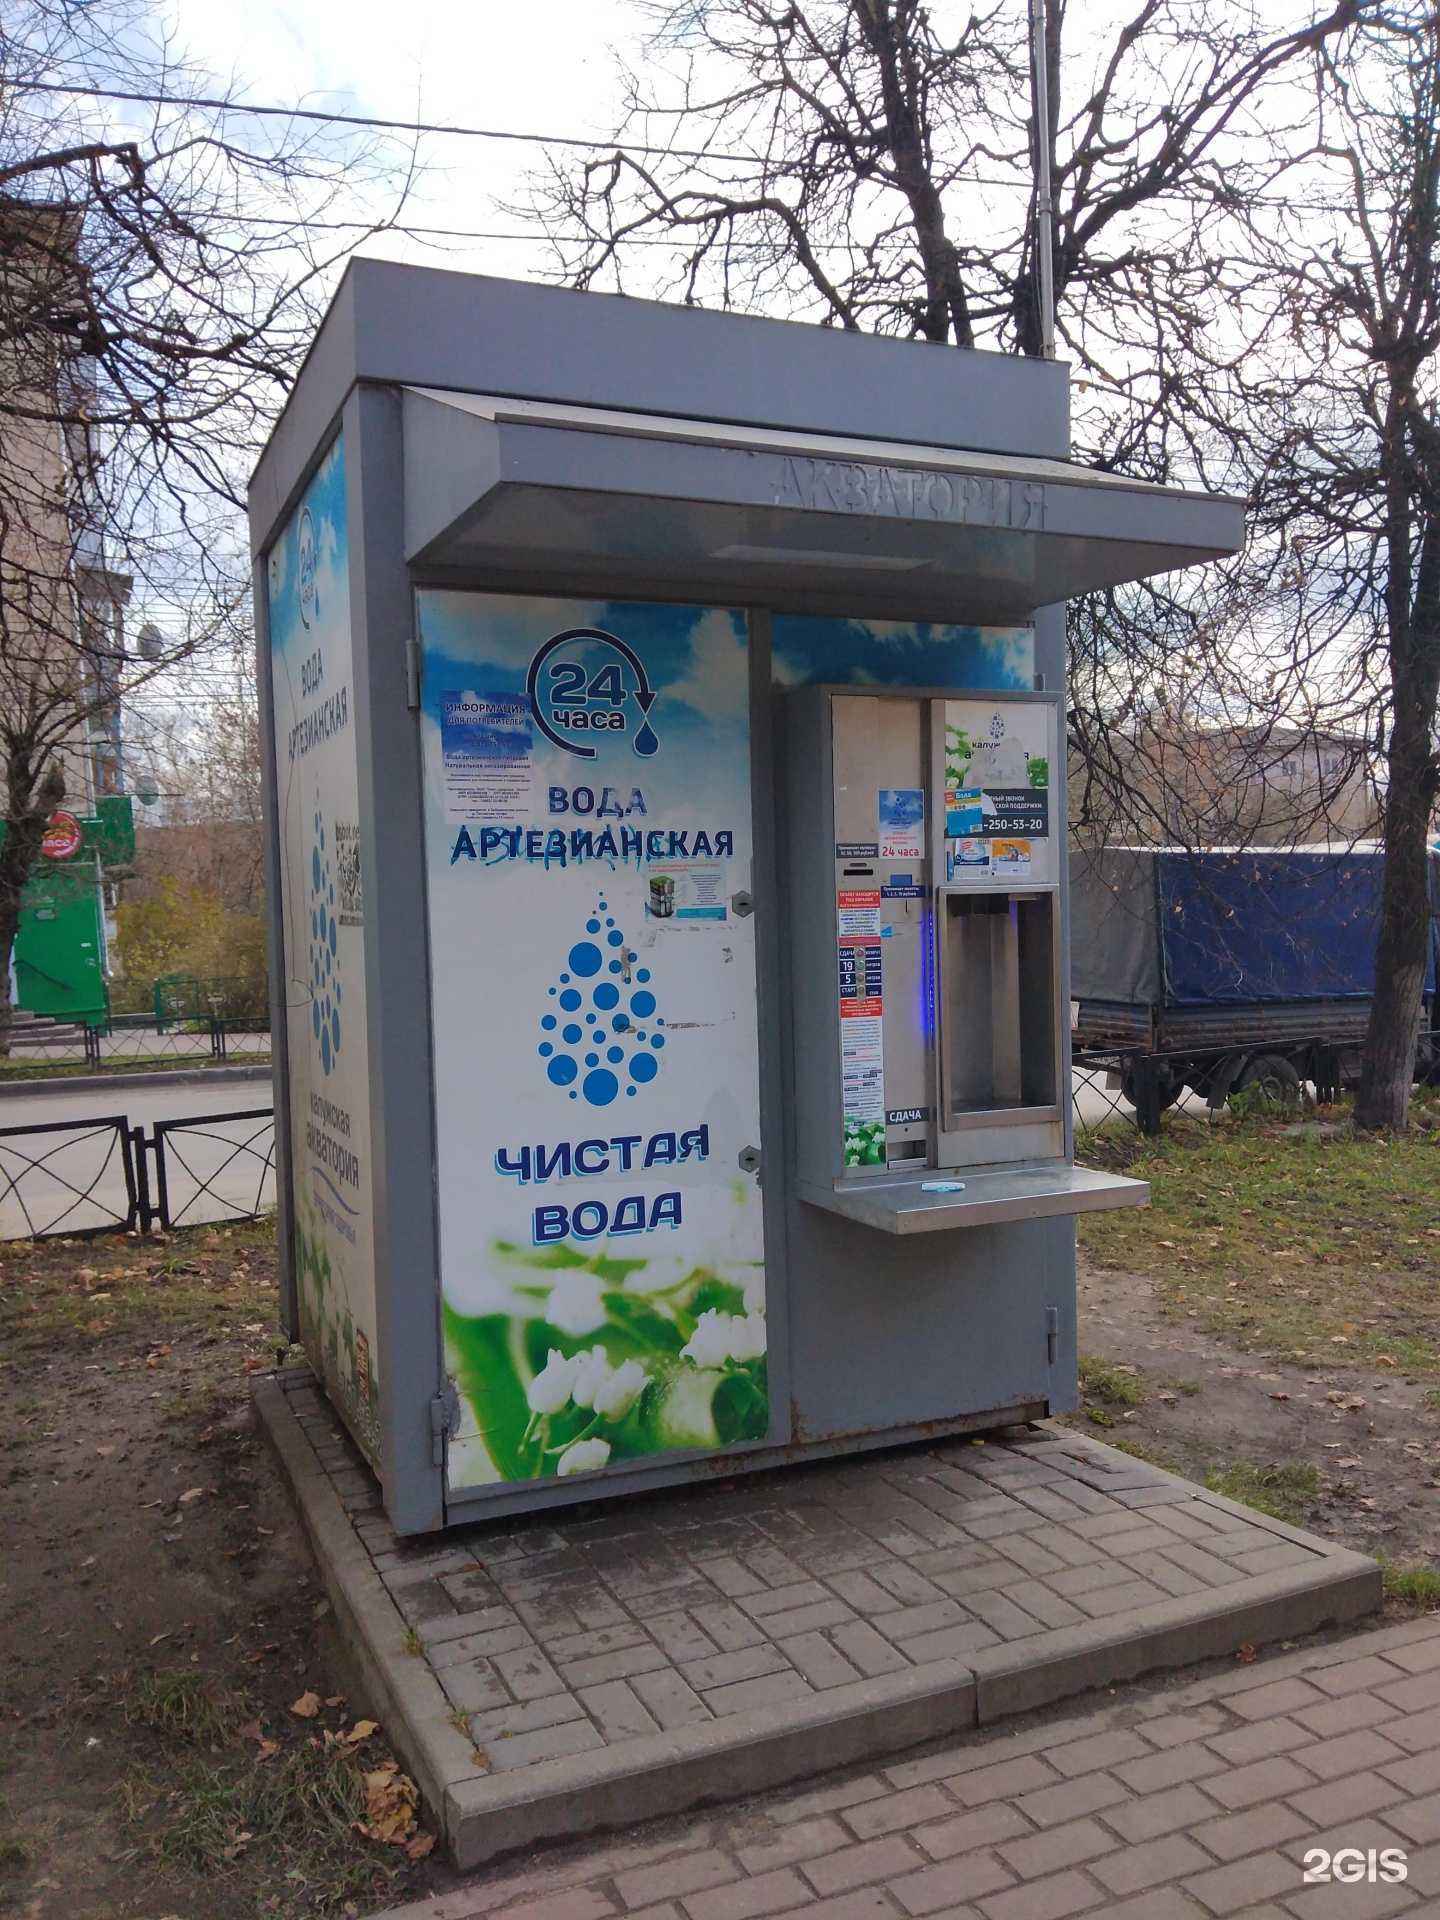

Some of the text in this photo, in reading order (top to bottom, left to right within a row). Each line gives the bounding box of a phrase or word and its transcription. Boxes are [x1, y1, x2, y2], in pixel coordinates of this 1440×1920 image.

[771, 457, 1047, 529] АКВАТОРИЯ
[302, 648, 323, 696] ВОДА
[550, 663, 627, 706] 24
[289, 686, 347, 762] АРТЕЗИАНСКАЯ
[446, 703, 525, 714] ИНФОРМАЦИЯ
[553, 710, 625, 730] часа
[549, 786, 648, 818] ВОДА
[984, 819, 1042, 830] -250-53-20
[452, 827, 734, 858] АРТЕЗИАНСКАЯ
[882, 846, 895, 857] 24
[897, 848, 920, 857] часа
[843, 961, 853, 971] 19
[845, 974, 851, 984] 5
[889, 1109, 921, 1122] СДАЧА
[307, 1121, 359, 1190] акватория
[496, 1124, 710, 1183] ЧИСТАЯ
[534, 1191, 682, 1244] ВОДА
